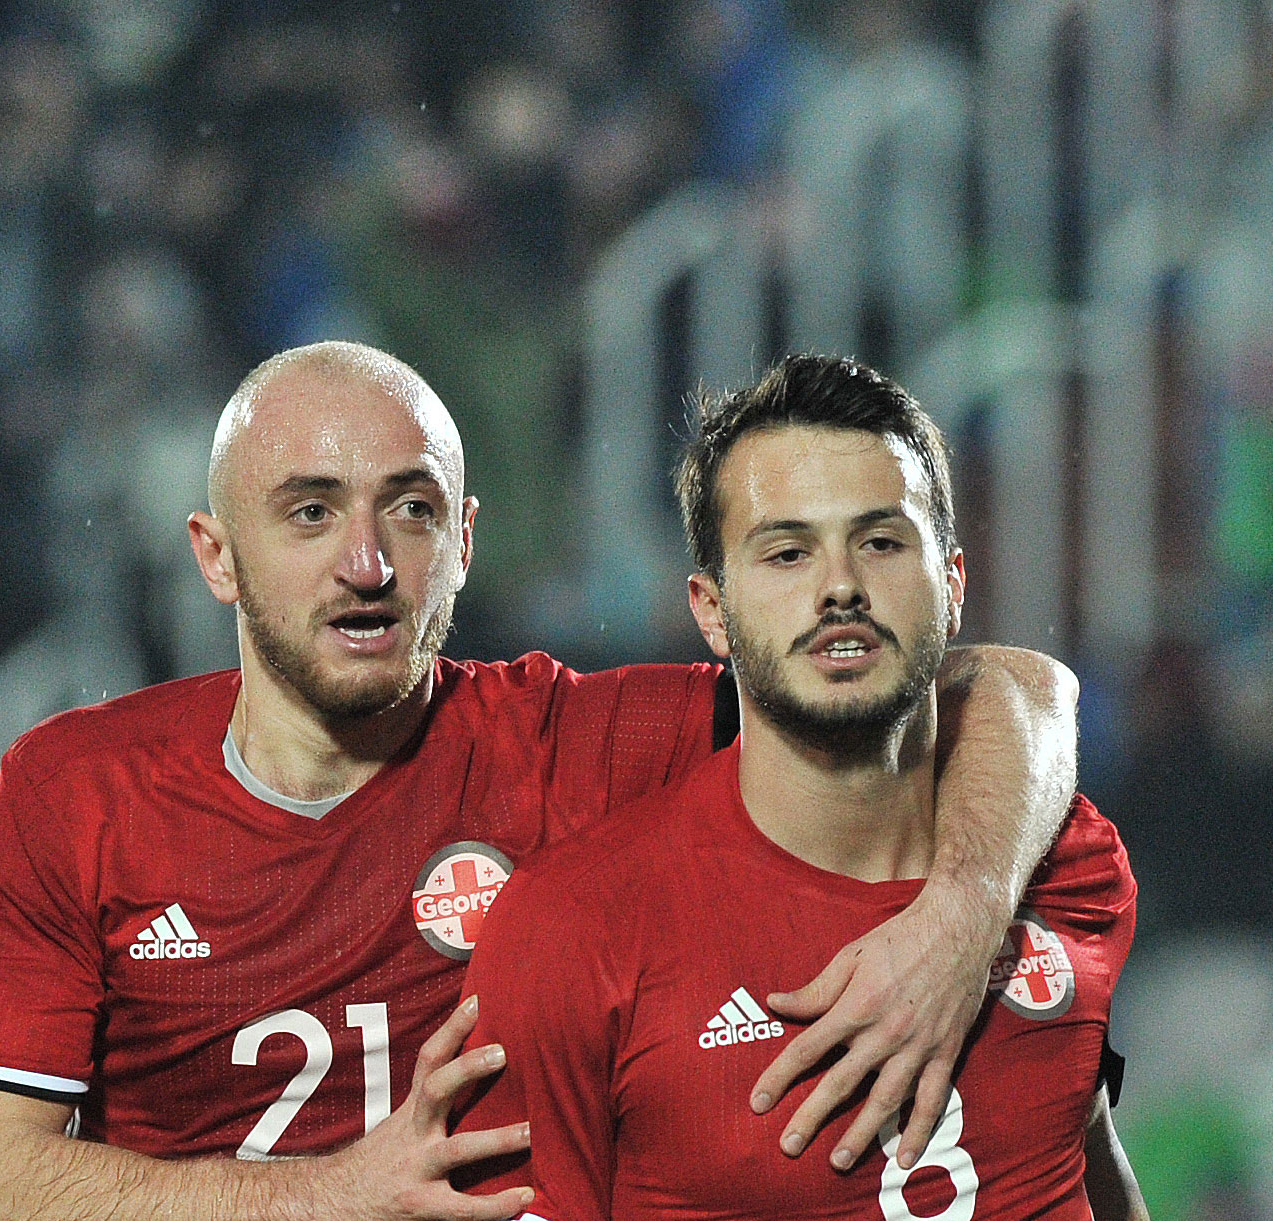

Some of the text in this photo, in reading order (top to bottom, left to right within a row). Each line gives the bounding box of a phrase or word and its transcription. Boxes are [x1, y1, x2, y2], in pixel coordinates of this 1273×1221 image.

[416, 882, 504, 920] Georg
[128, 936, 212, 962] adidas
[697, 1017, 785, 1051] adidas
[231, 1001, 392, 1162] 21
